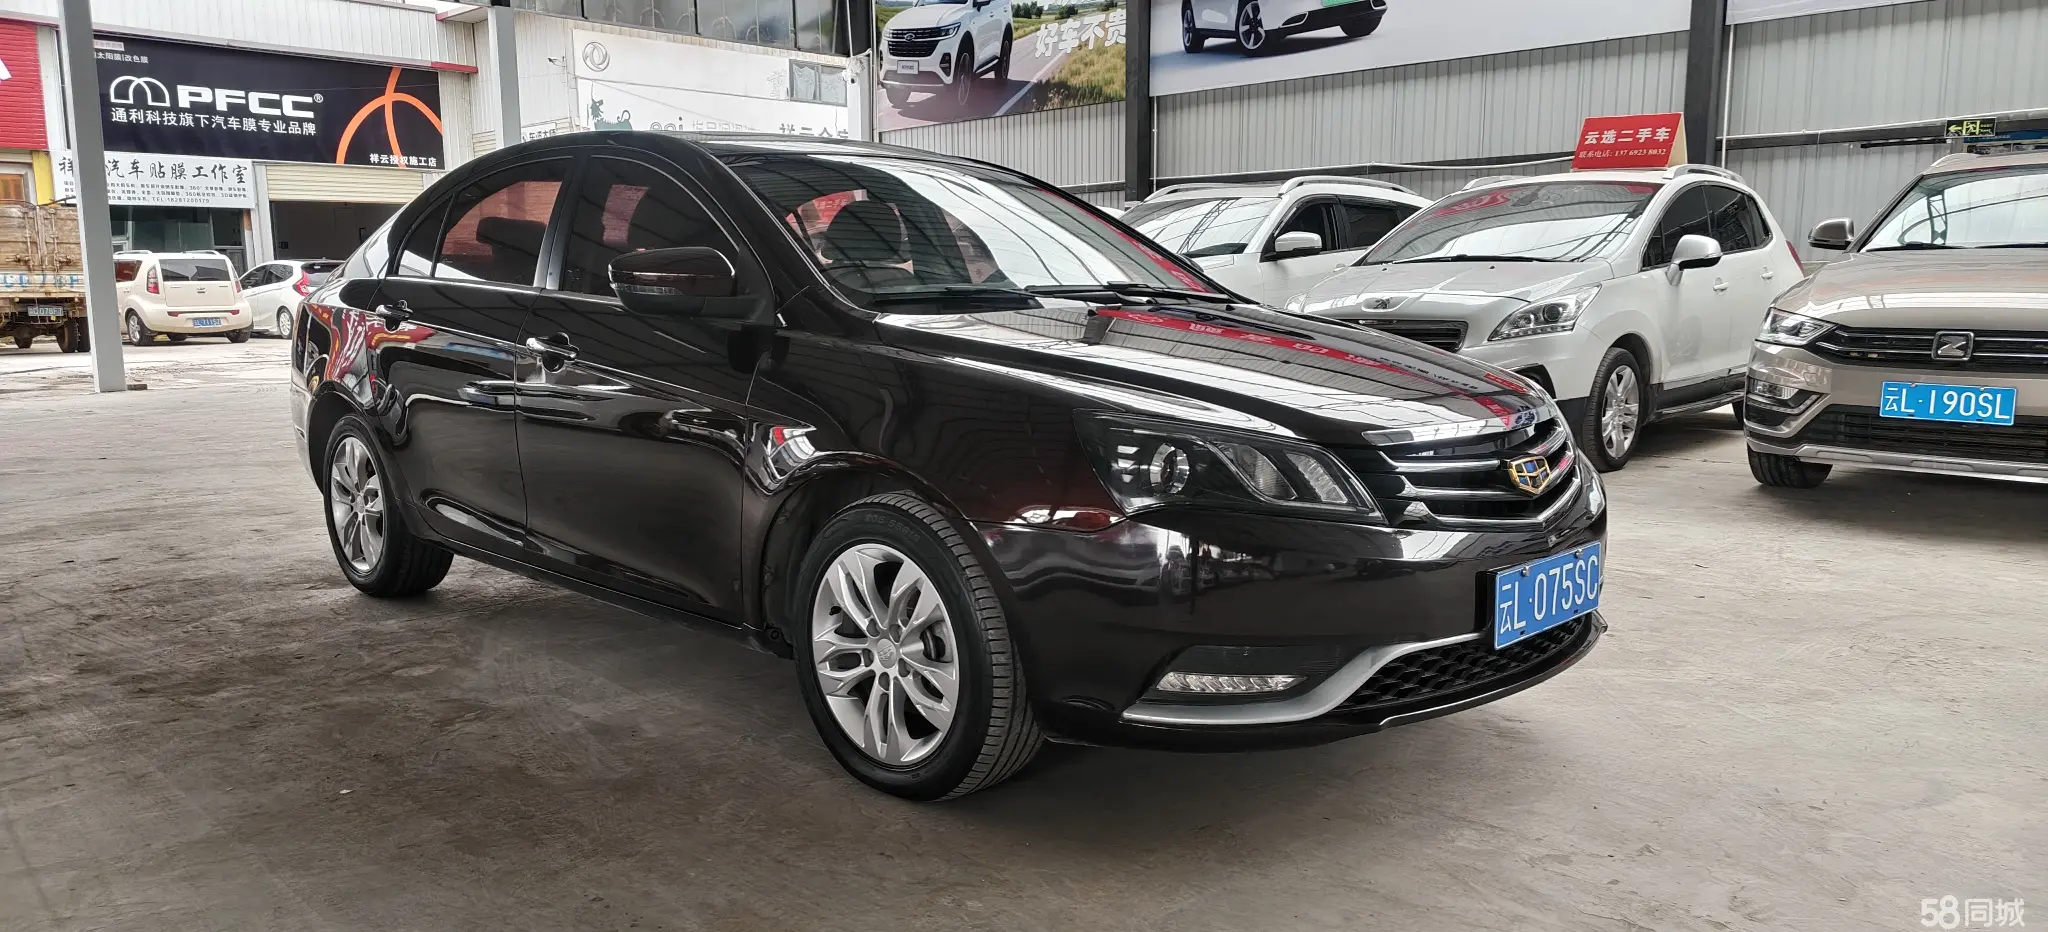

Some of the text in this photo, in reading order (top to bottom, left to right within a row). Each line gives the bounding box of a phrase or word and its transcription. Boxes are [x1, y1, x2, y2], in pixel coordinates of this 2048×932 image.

[1034, 8, 1127, 58] 好车不贵
[111, 107, 317, 136] 通利科技旗下汽车膜专业品牌
[1584, 127, 1672, 145] 云选二手车
[369, 153, 437, 167] 祥云授权施工店
[1884, 387, 2011, 420] 云L·190SL
[1500, 555, 1598, 635] 云L·075SC
